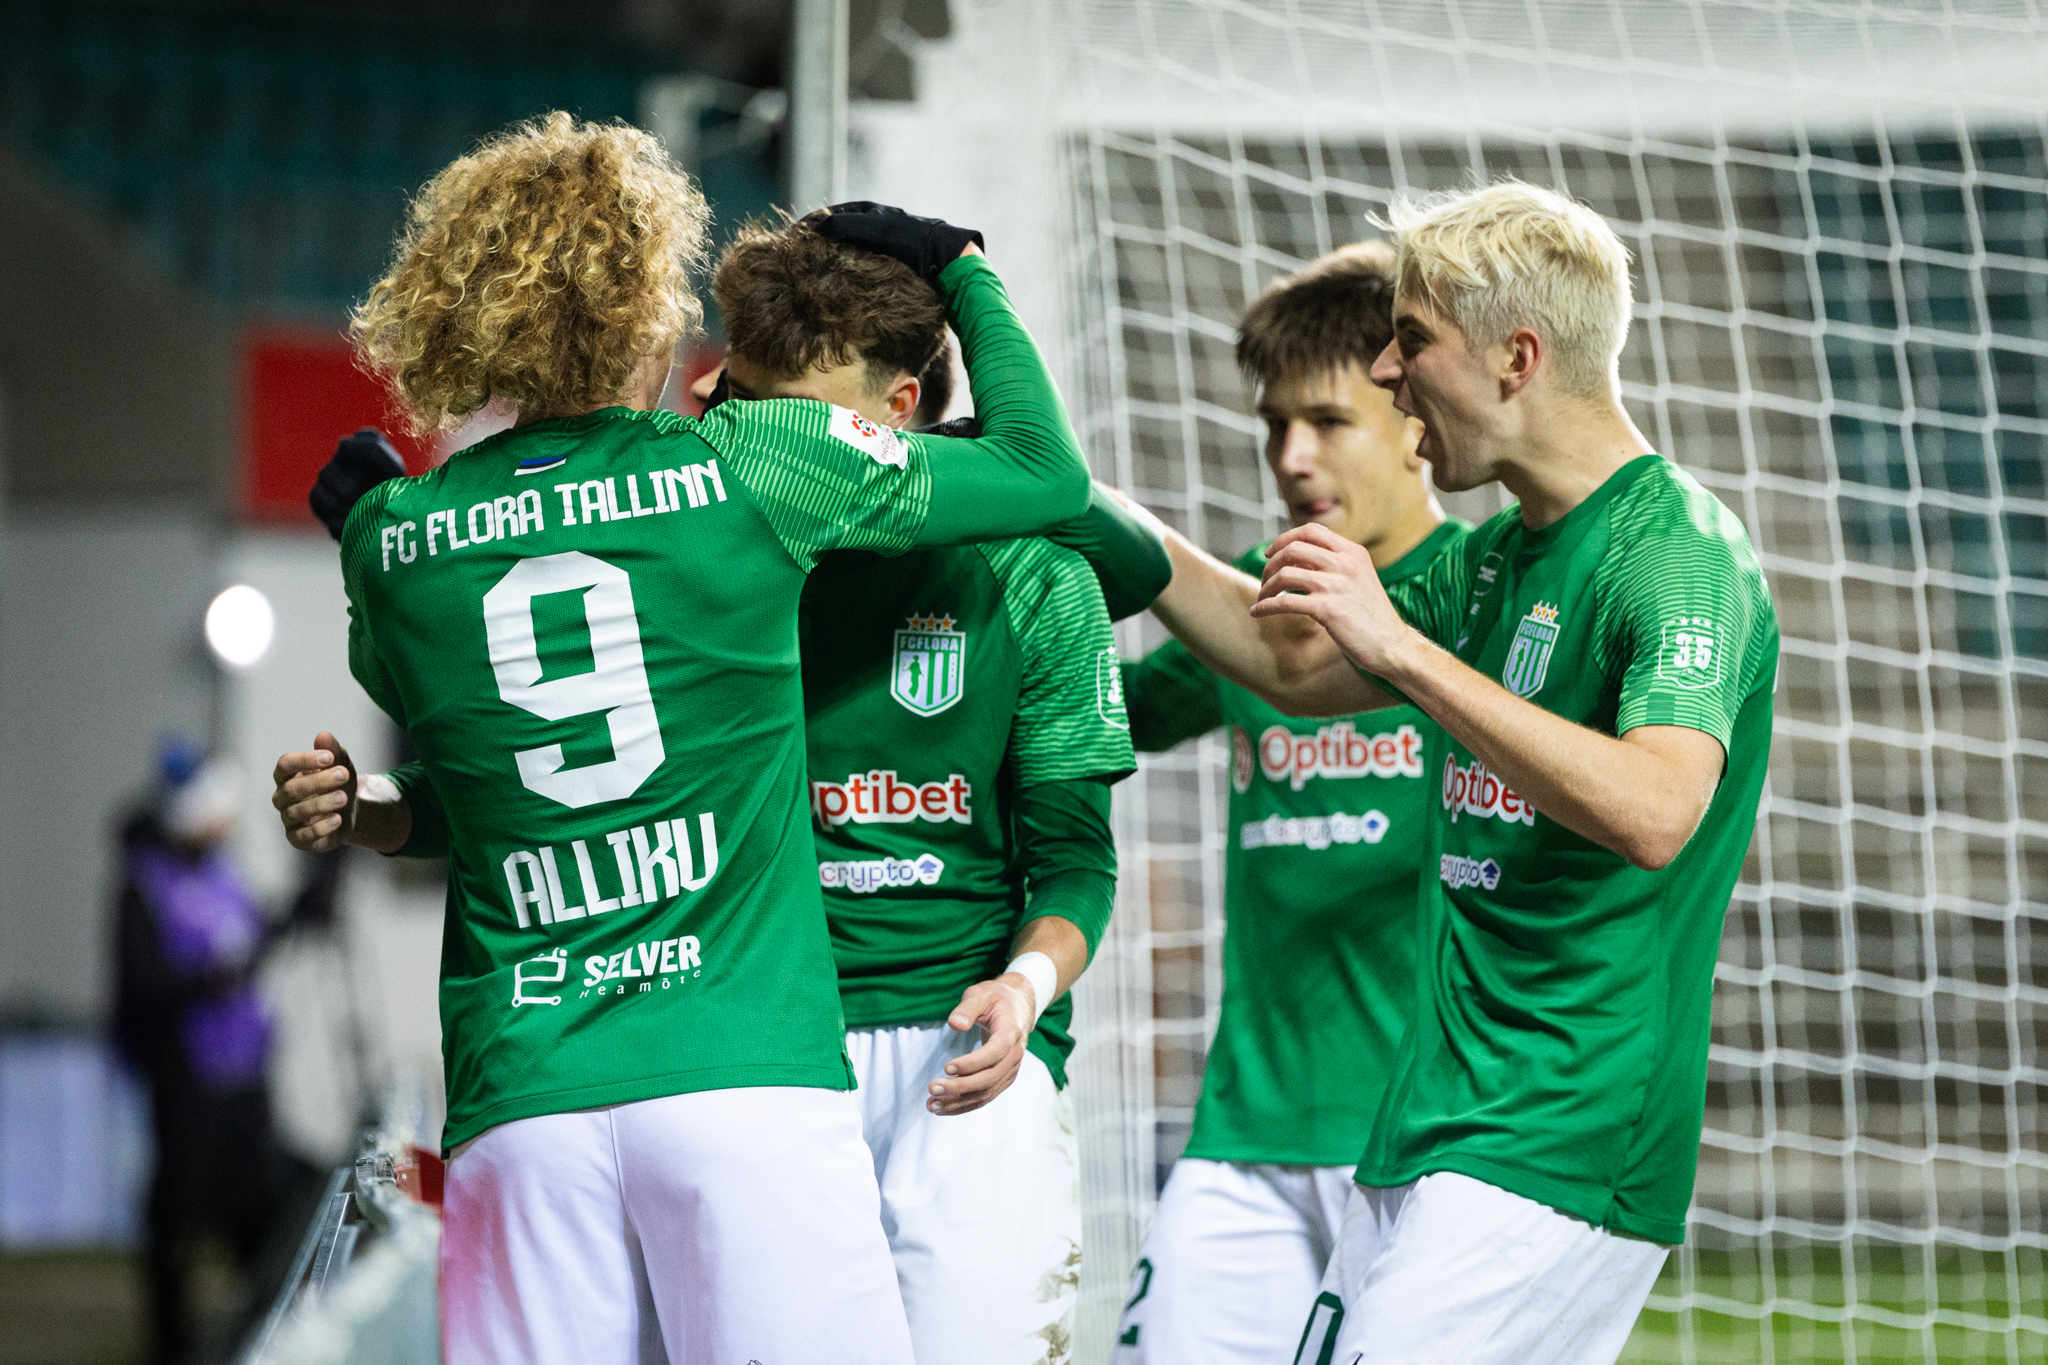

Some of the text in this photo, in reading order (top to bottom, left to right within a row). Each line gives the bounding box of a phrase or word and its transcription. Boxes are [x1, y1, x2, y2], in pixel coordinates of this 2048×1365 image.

[381, 458, 728, 572] FC FLORA TALLINN
[1673, 632, 1714, 670] 35
[482, 550, 667, 809] 9
[1262, 728, 1418, 780] Optibet
[808, 772, 969, 827] ptibet
[502, 811, 719, 929] ALLIKU
[820, 861, 915, 889] crypto
[583, 935, 702, 987] SELVER
